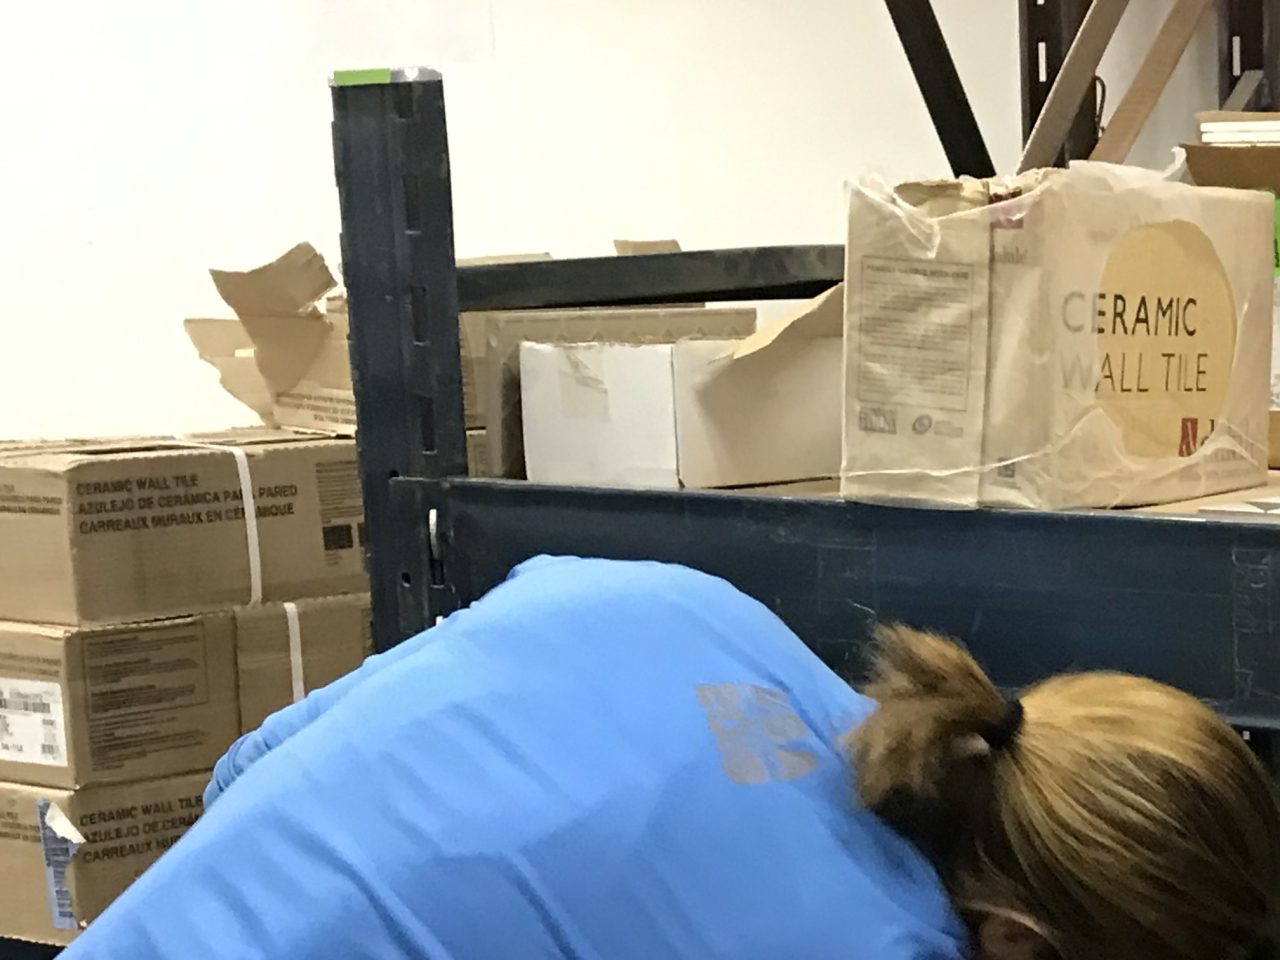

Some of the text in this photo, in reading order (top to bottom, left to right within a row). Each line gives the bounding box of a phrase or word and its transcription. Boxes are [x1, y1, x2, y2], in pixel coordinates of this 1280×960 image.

[1062, 290, 1197, 337] CERAMIC
[1061, 352, 1208, 393] WALL TILE
[76, 473, 199, 496] CERAMIC WALL TILE
[139, 496, 154, 510] DE
[258, 484, 298, 499] PARED
[79, 502, 295, 535] CARREAUX MURAUX EN CERMIQUE
[80, 794, 203, 827] CERAMIC WALL TILE
[143, 822, 158, 835] DE
[82, 842, 153, 863] CARREAUX
